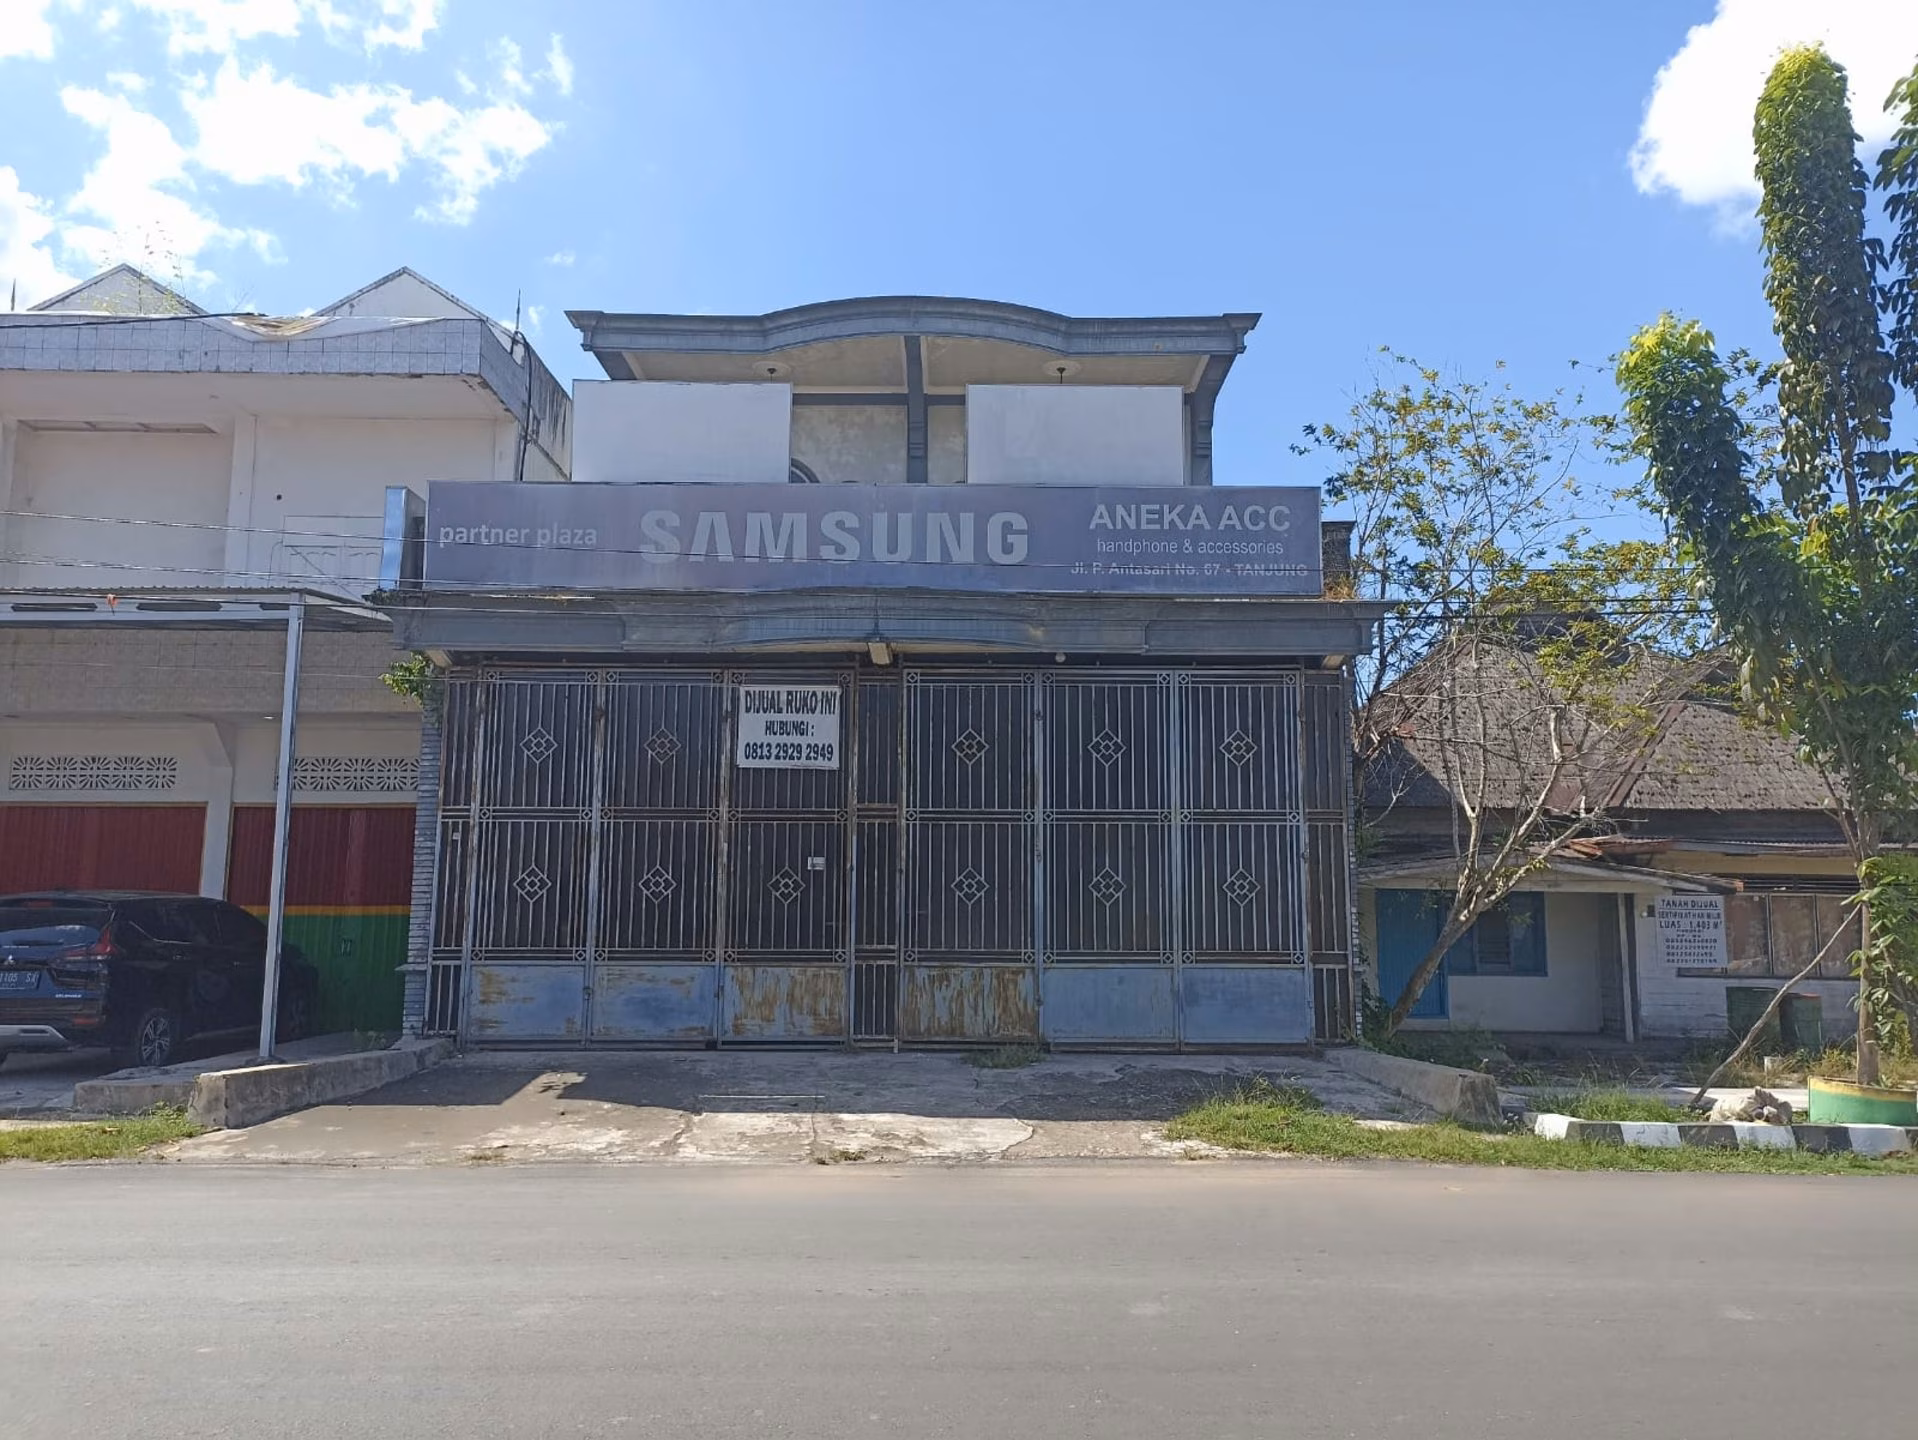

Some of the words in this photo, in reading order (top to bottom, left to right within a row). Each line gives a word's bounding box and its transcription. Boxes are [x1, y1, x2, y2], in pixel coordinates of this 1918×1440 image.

[1088, 503, 1212, 531] ANEKA
[1218, 504, 1291, 532] ACC
[439, 523, 530, 548] partner
[537, 522, 598, 547] plaza
[638, 510, 1029, 565] SAMSUNG
[1096, 538, 1178, 557] handphone
[1182, 538, 1194, 554] &
[1197, 540, 1284, 555] accessories
[1109, 561, 1170, 576] Antasari
[1174, 562, 1199, 577] No.
[1234, 563, 1309, 577] TANJUNG
[744, 690, 784, 714] DIJUAL
[785, 690, 818, 715] RUKO
[820, 690, 838, 716] INI
[744, 742, 772, 760] 0813
[774, 743, 803, 761] 2929
[805, 743, 834, 761] 2949
[1661, 899, 1689, 908] TANAH
[1690, 899, 1719, 908] DIJUAL
[1660, 920, 1681, 929] LUAS
